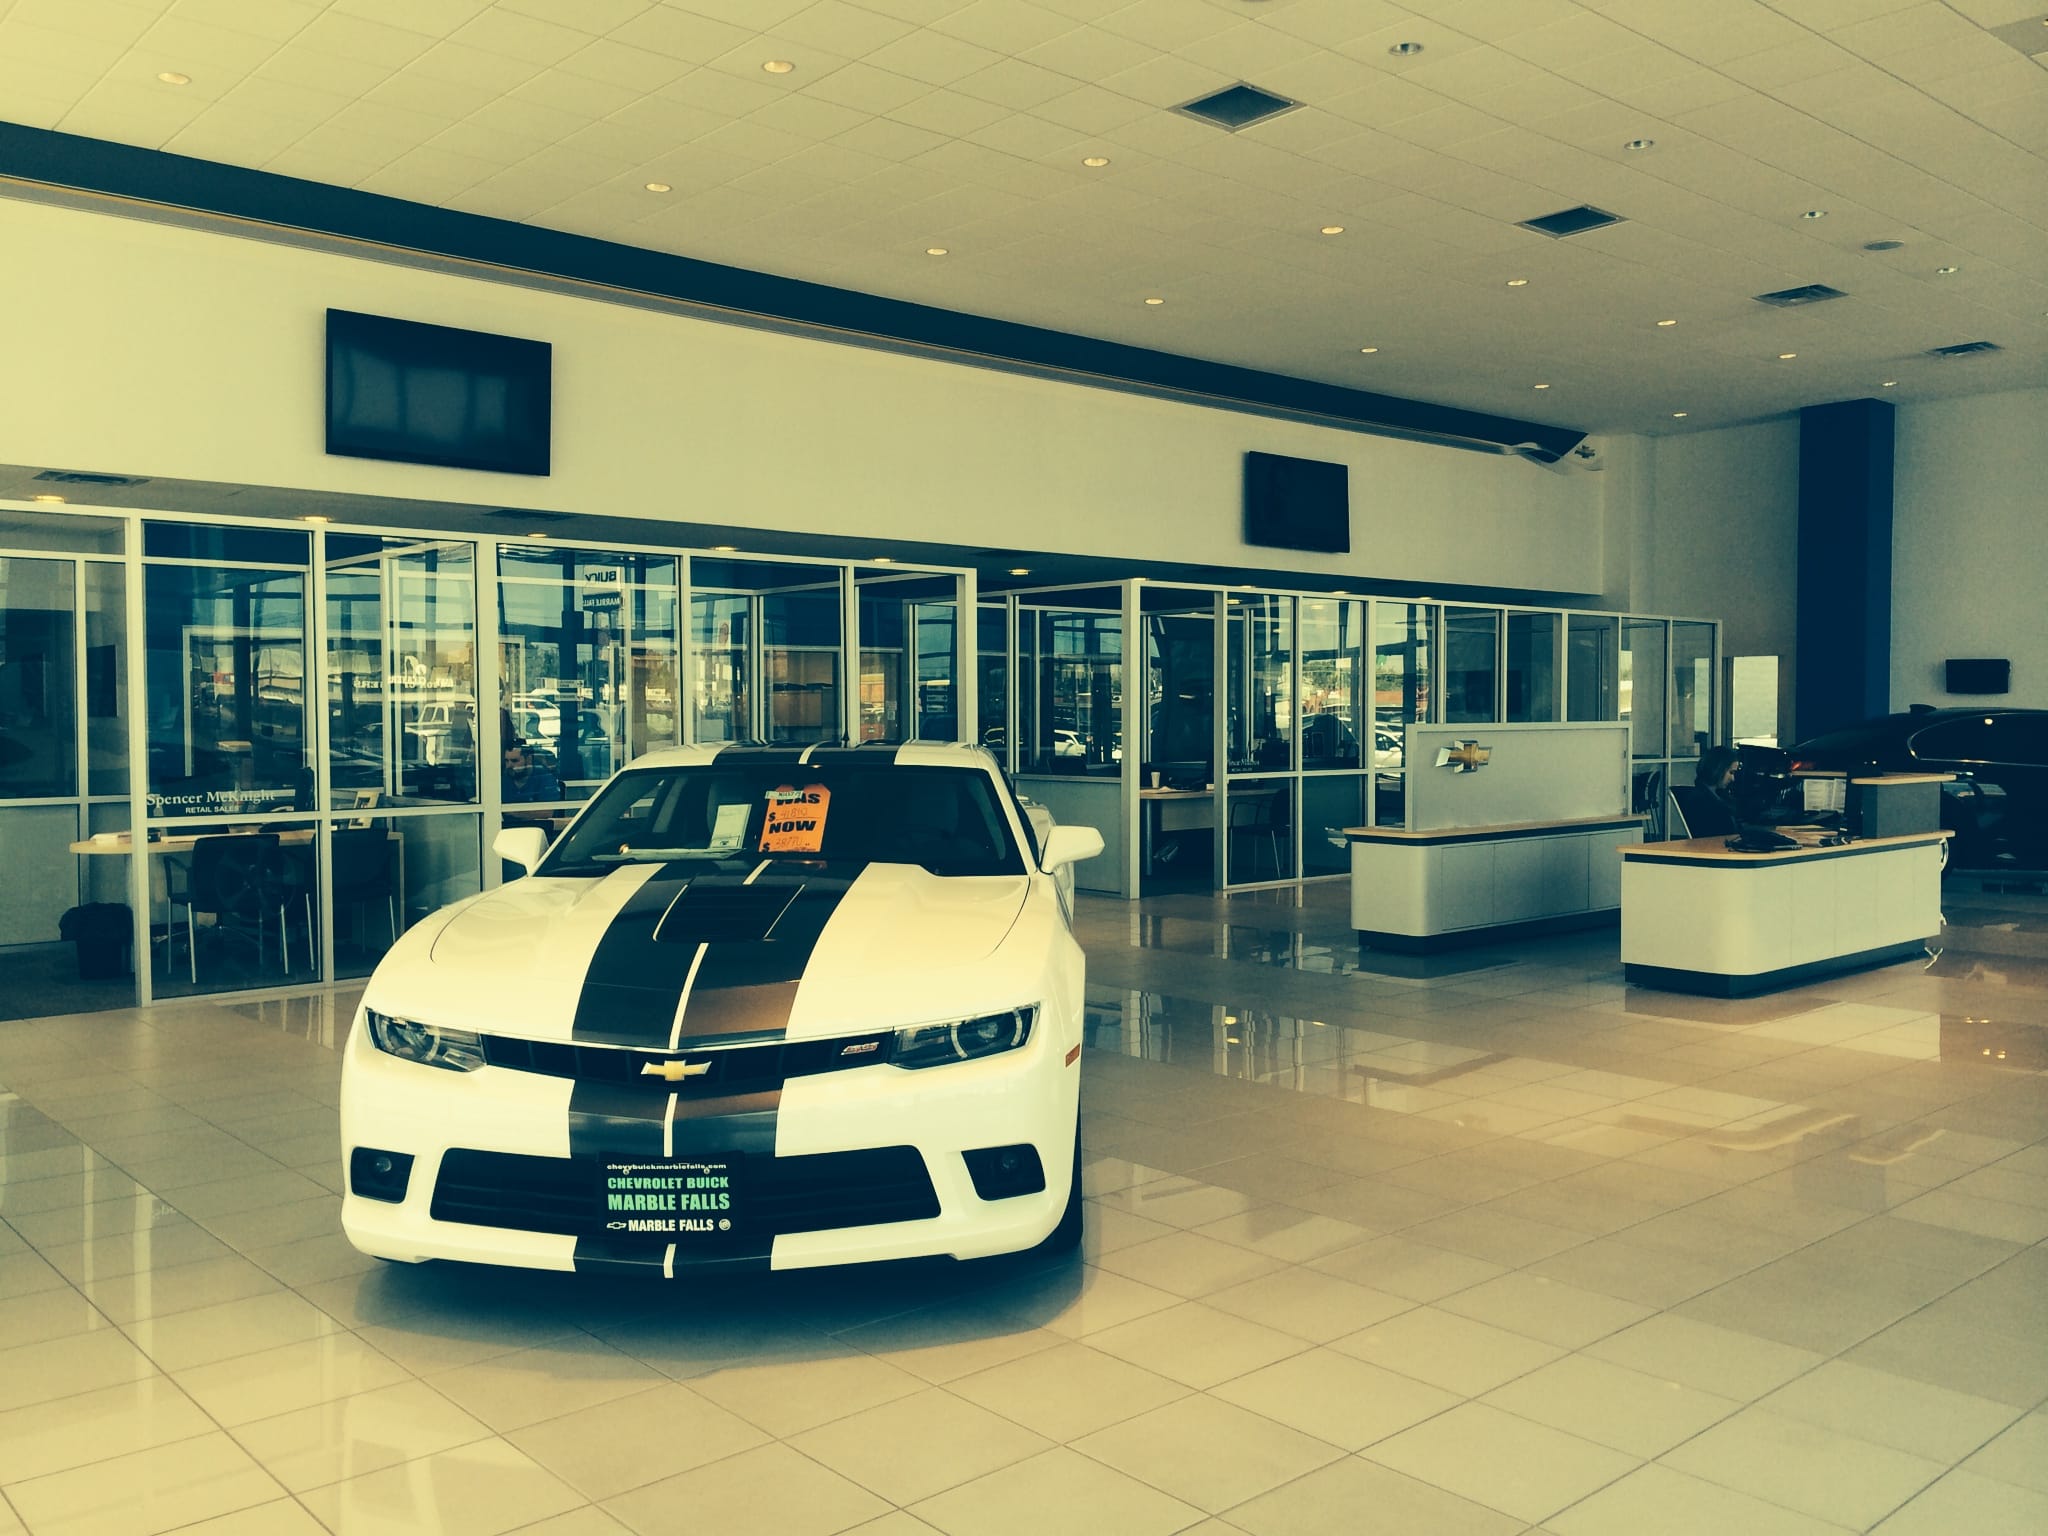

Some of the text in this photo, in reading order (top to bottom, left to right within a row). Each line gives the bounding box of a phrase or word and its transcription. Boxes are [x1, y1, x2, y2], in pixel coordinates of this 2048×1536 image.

[147, 789, 276, 808] Spencer McKnight
[185, 805, 240, 814] RETAIL SALES
[769, 820, 817, 834] NOW
[606, 1162, 727, 1171] chevybuickmarblefalls.com
[606, 1176, 729, 1189] CHEVROLET BUICK
[607, 1192, 731, 1211] MARBLE FALLS
[627, 1218, 714, 1231] MARBLE FALLS
